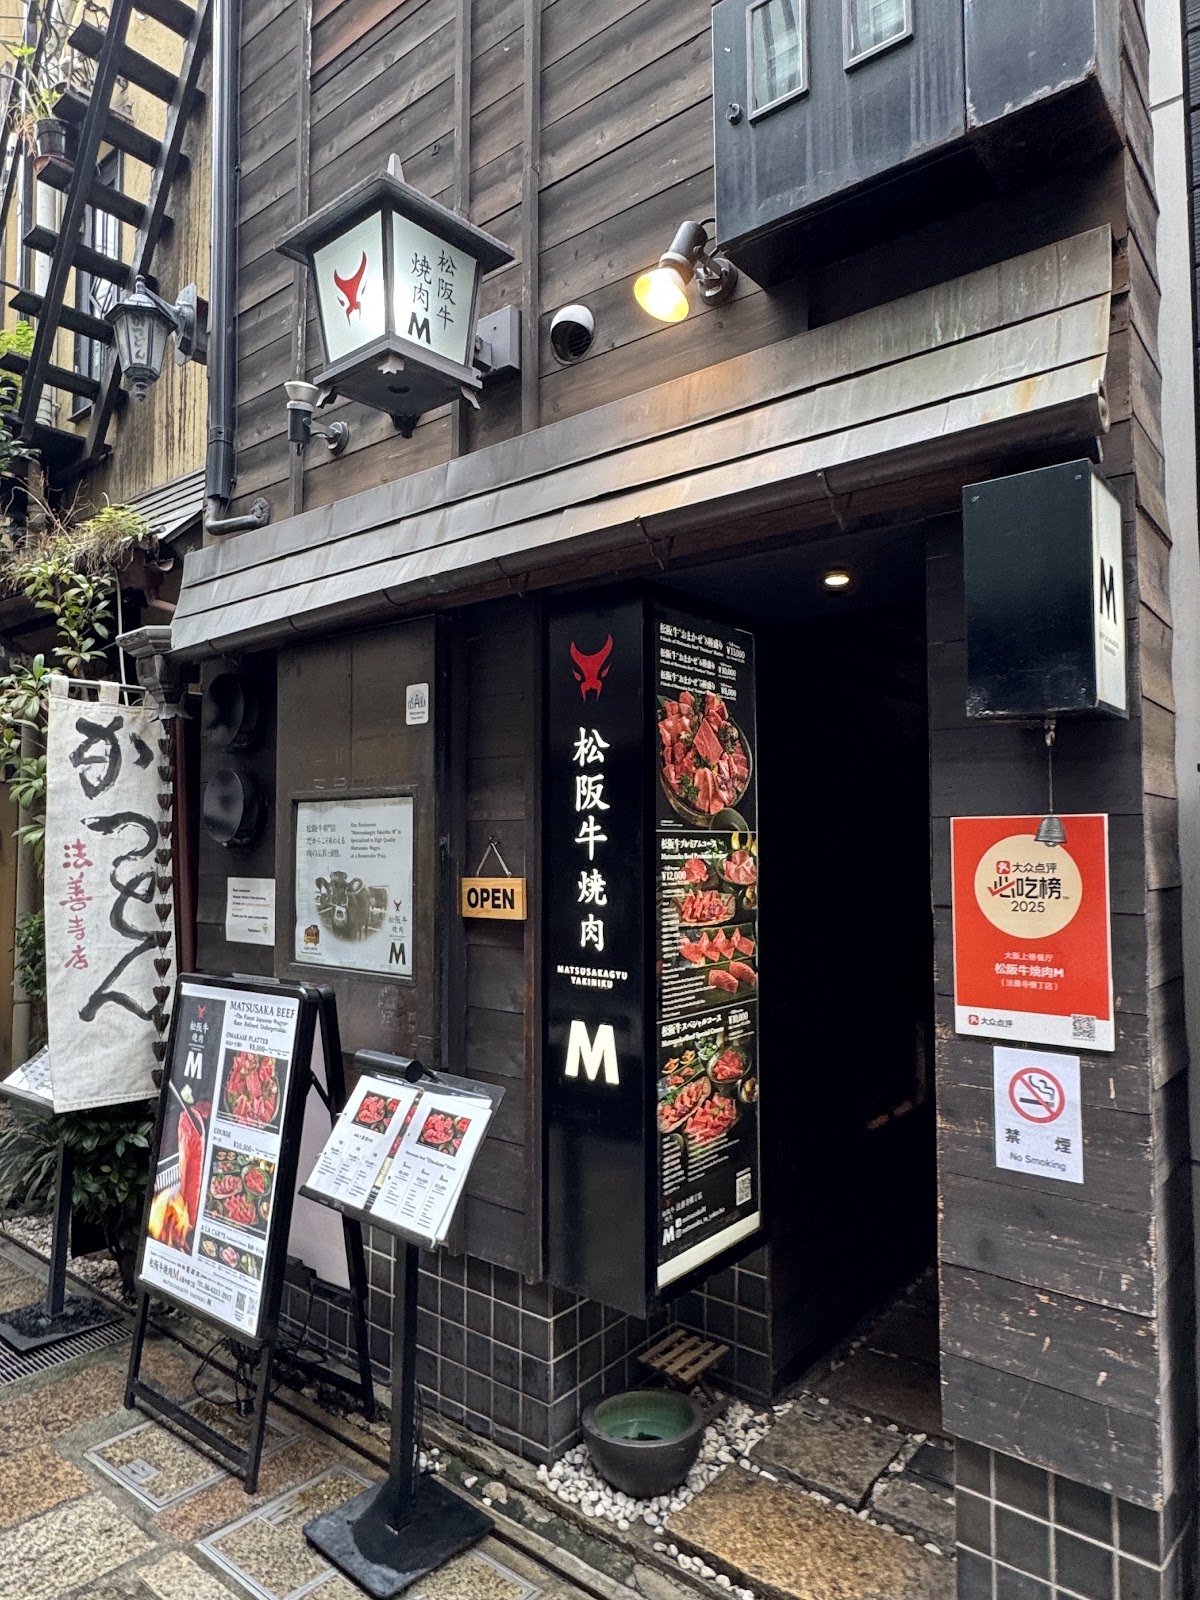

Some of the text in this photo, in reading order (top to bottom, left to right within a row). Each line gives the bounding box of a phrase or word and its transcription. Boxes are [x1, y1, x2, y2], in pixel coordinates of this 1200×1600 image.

[436, 249, 457, 331] 松阪牛
[1100, 556, 1117, 626] M
[572, 727, 611, 952] 松阪牛焼肉
[1012, 863, 1057, 874] 大众点评
[59, 839, 93, 971] 法善寺店
[467, 888, 515, 909] OPEN
[1011, 901, 1045, 913] 2025
[389, 942, 406, 965] M
[557, 965, 628, 980] MATSUSAKAGYU
[571, 976, 613, 989] YAKINIKU
[230, 1001, 295, 1019] MATSUSAKA BEEF
[564, 1019, 620, 1085] M
[184, 1051, 203, 1079] M
[1010, 1152, 1067, 1172] No Smoking
[662, 1225, 675, 1246] M
